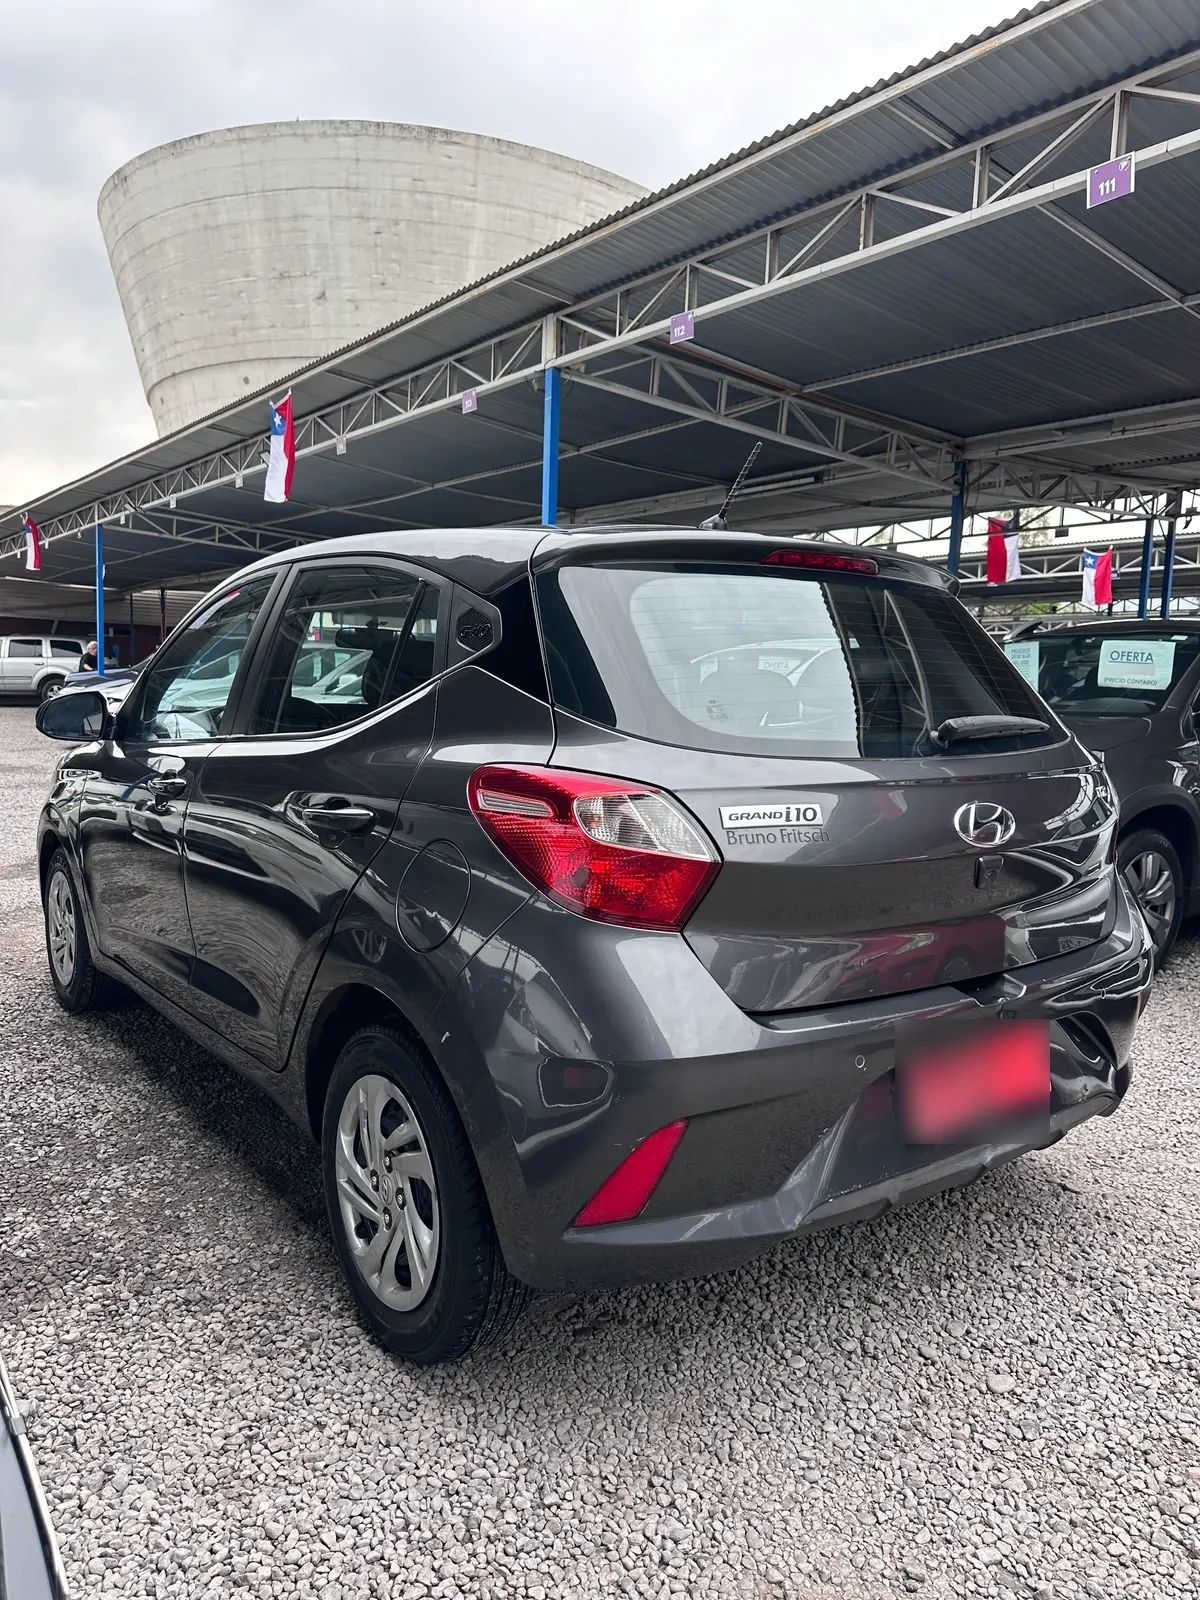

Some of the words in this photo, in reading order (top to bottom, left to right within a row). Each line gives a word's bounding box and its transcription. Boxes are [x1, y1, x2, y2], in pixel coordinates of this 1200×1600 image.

[1098, 177, 1116, 196] 111
[674, 325, 686, 337] 112
[1110, 650, 1154, 662] OFERTA
[1127, 678, 1158, 687] CONTADO)
[728, 811, 783, 821] GRAND
[785, 806, 818, 822] i10
[725, 830, 777, 846] Bruno
[779, 828, 830, 843] Fritsch
